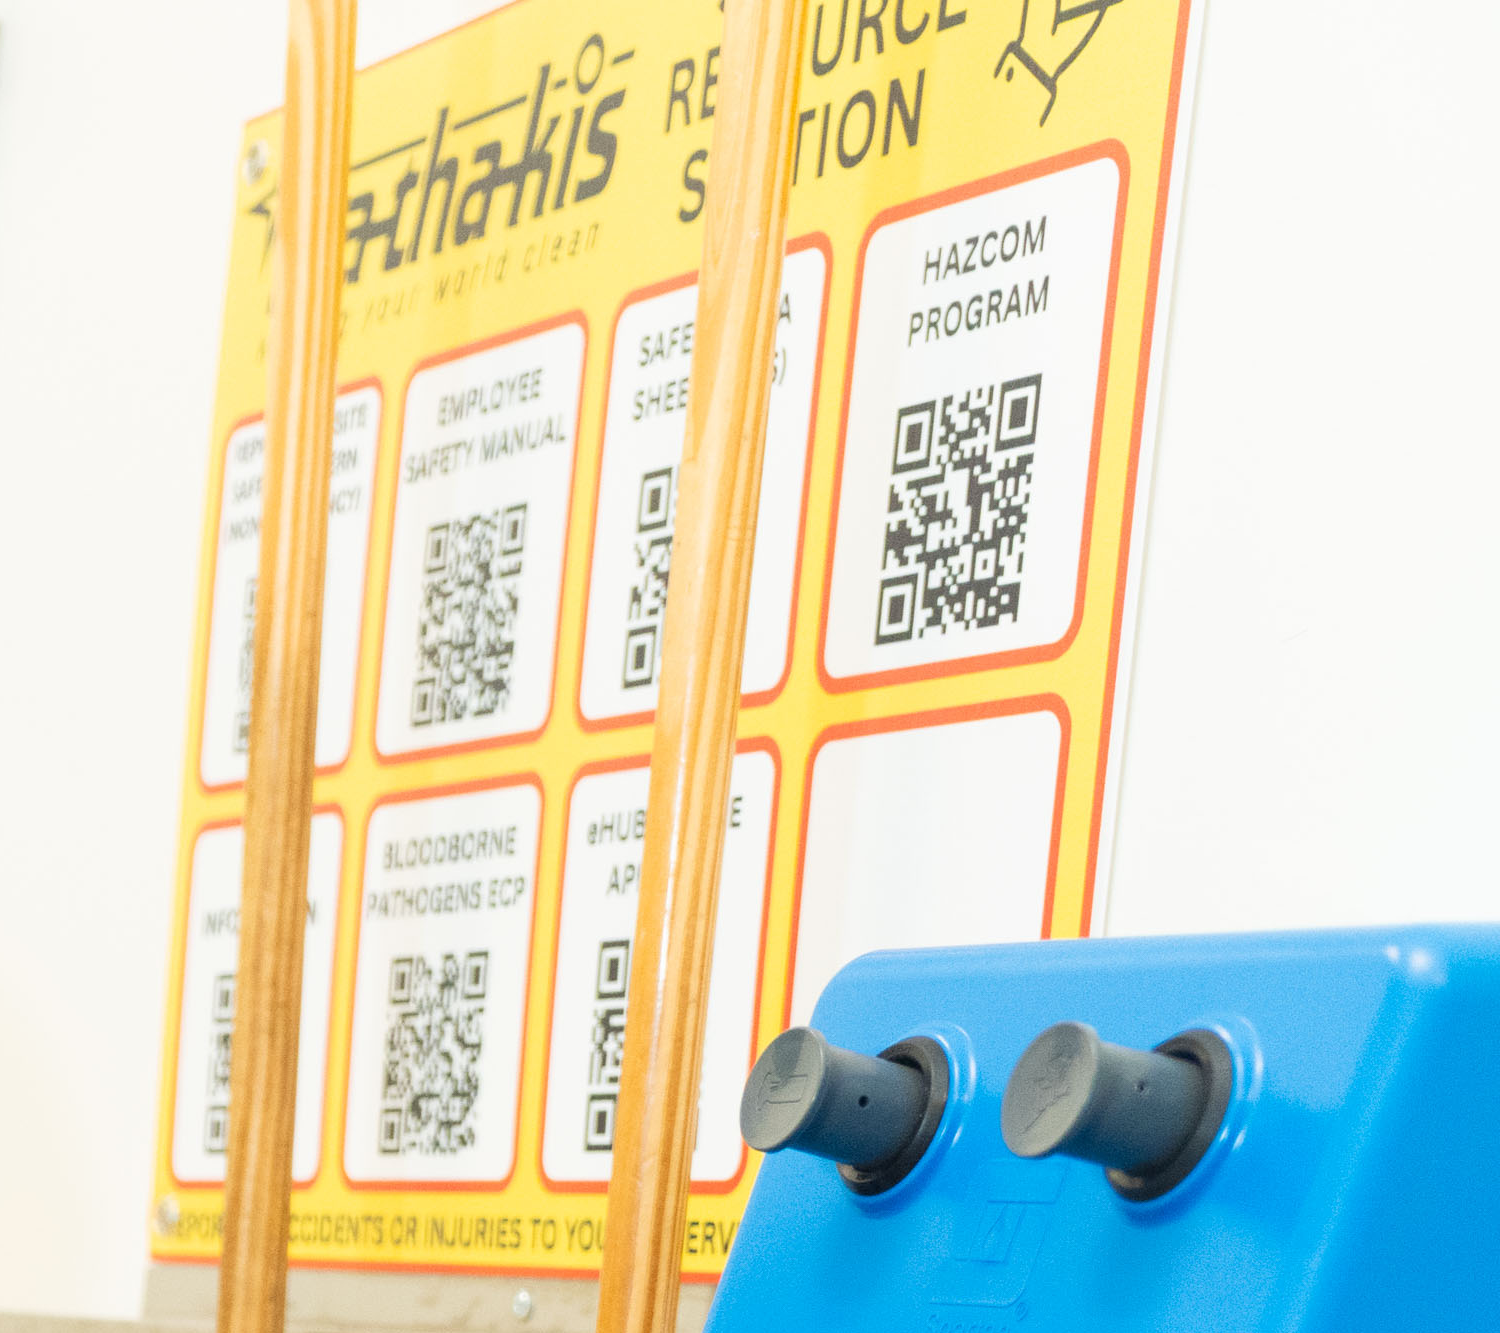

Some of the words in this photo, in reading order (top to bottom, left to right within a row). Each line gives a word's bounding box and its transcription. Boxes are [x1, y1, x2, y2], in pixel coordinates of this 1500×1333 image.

[524, 223, 600, 280] clean
[923, 216, 1047, 284] HAZCOM
[909, 275, 1049, 347] PROGRAM
[438, 369, 543, 427] EMPLOYEE
[405, 438, 476, 483] SAFETY
[479, 413, 566, 463] MANUAL
[384, 826, 517, 870] BLOODBORNE
[367, 879, 481, 919] PATHOGENS
[487, 876, 526, 909] ECP
[288, 1213, 384, 1246] CCIDENTS
[389, 1214, 418, 1247] OR
[424, 1216, 520, 1249] INJURIES
[530, 1218, 556, 1250] TO
